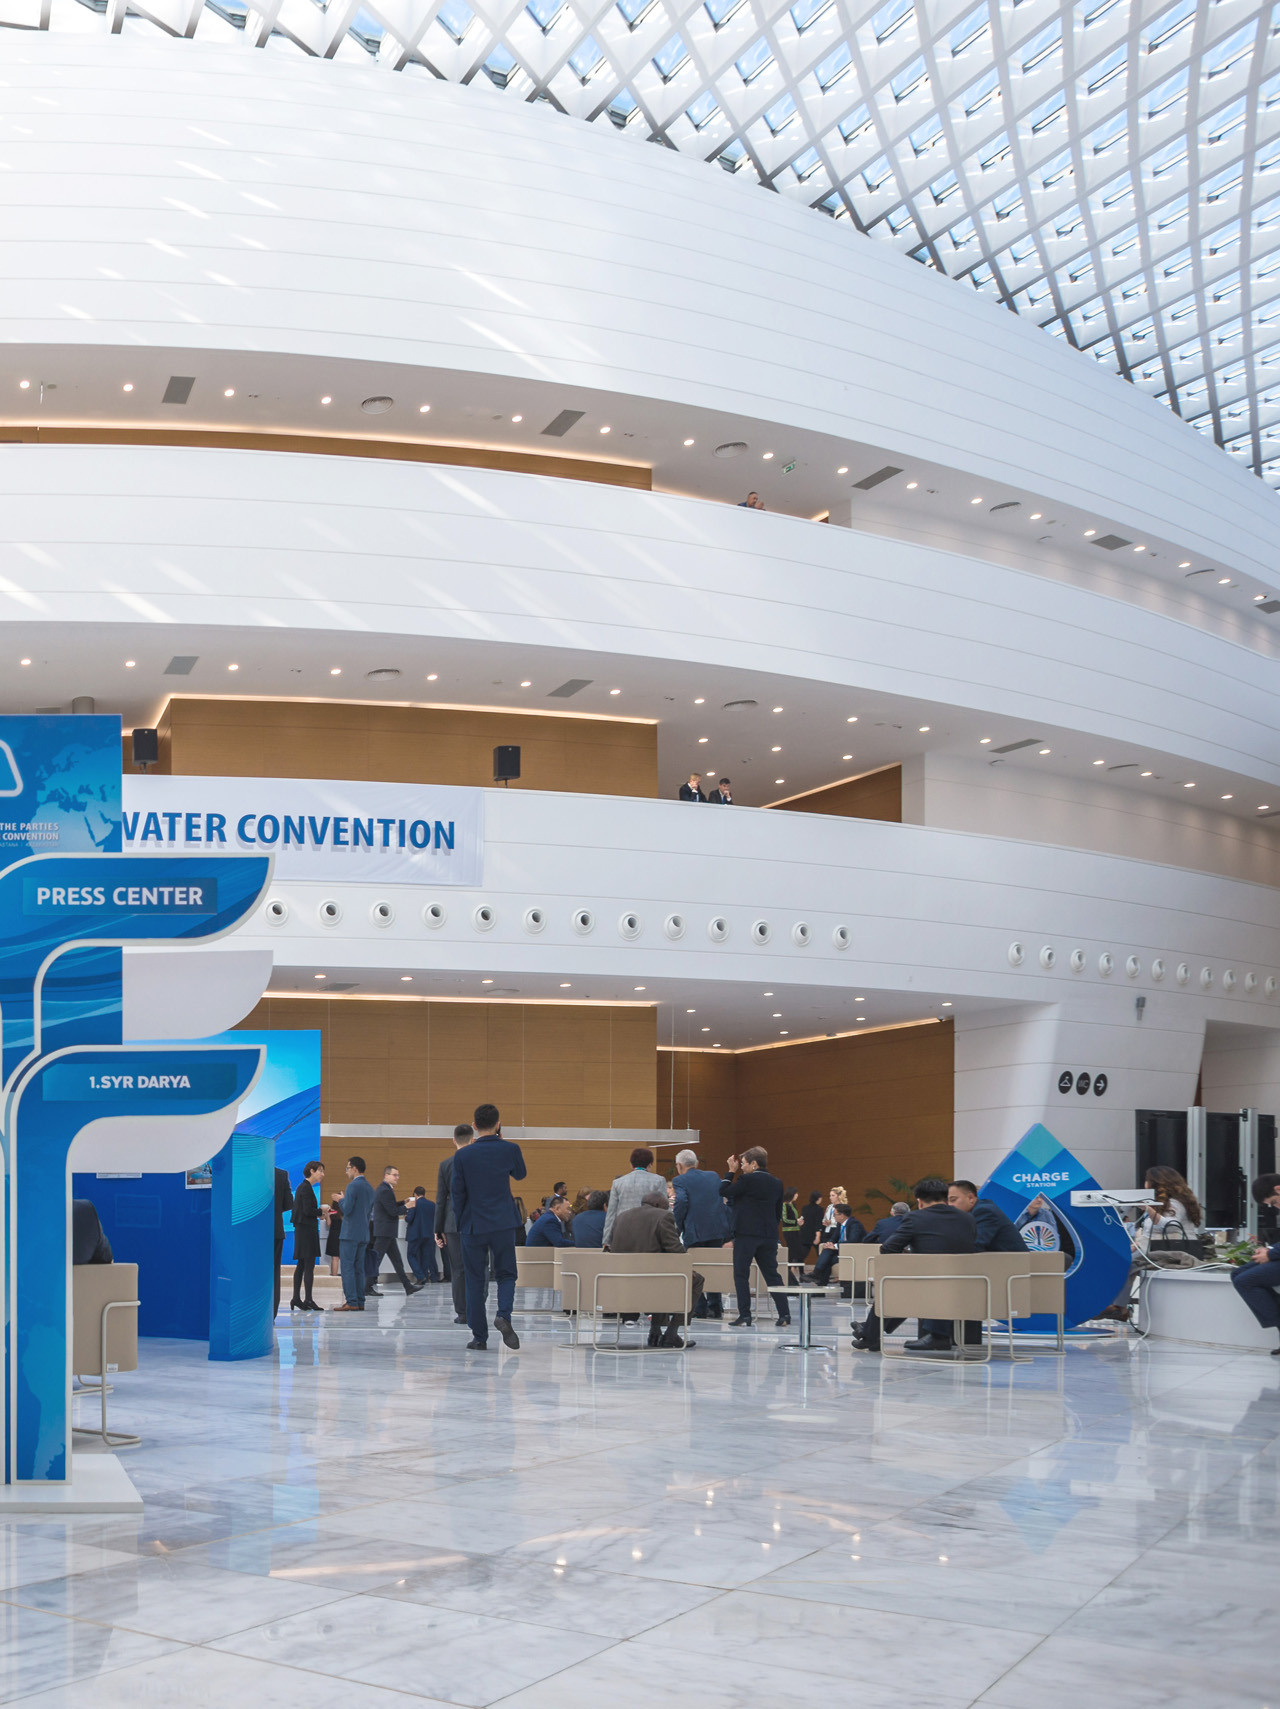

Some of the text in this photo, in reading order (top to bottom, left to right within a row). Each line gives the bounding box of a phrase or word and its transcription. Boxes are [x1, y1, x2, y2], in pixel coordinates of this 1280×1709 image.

[0, 823, 17, 831] THE
[20, 823, 59, 831] PARTIES
[236, 813, 456, 850] CONVENTION
[2, 832, 59, 840] CONVENTION
[37, 887, 203, 905] PRESS CENTER
[89, 1076, 191, 1089] 1.SYR DARYA
[1013, 1172, 1070, 1183] CHARGE
